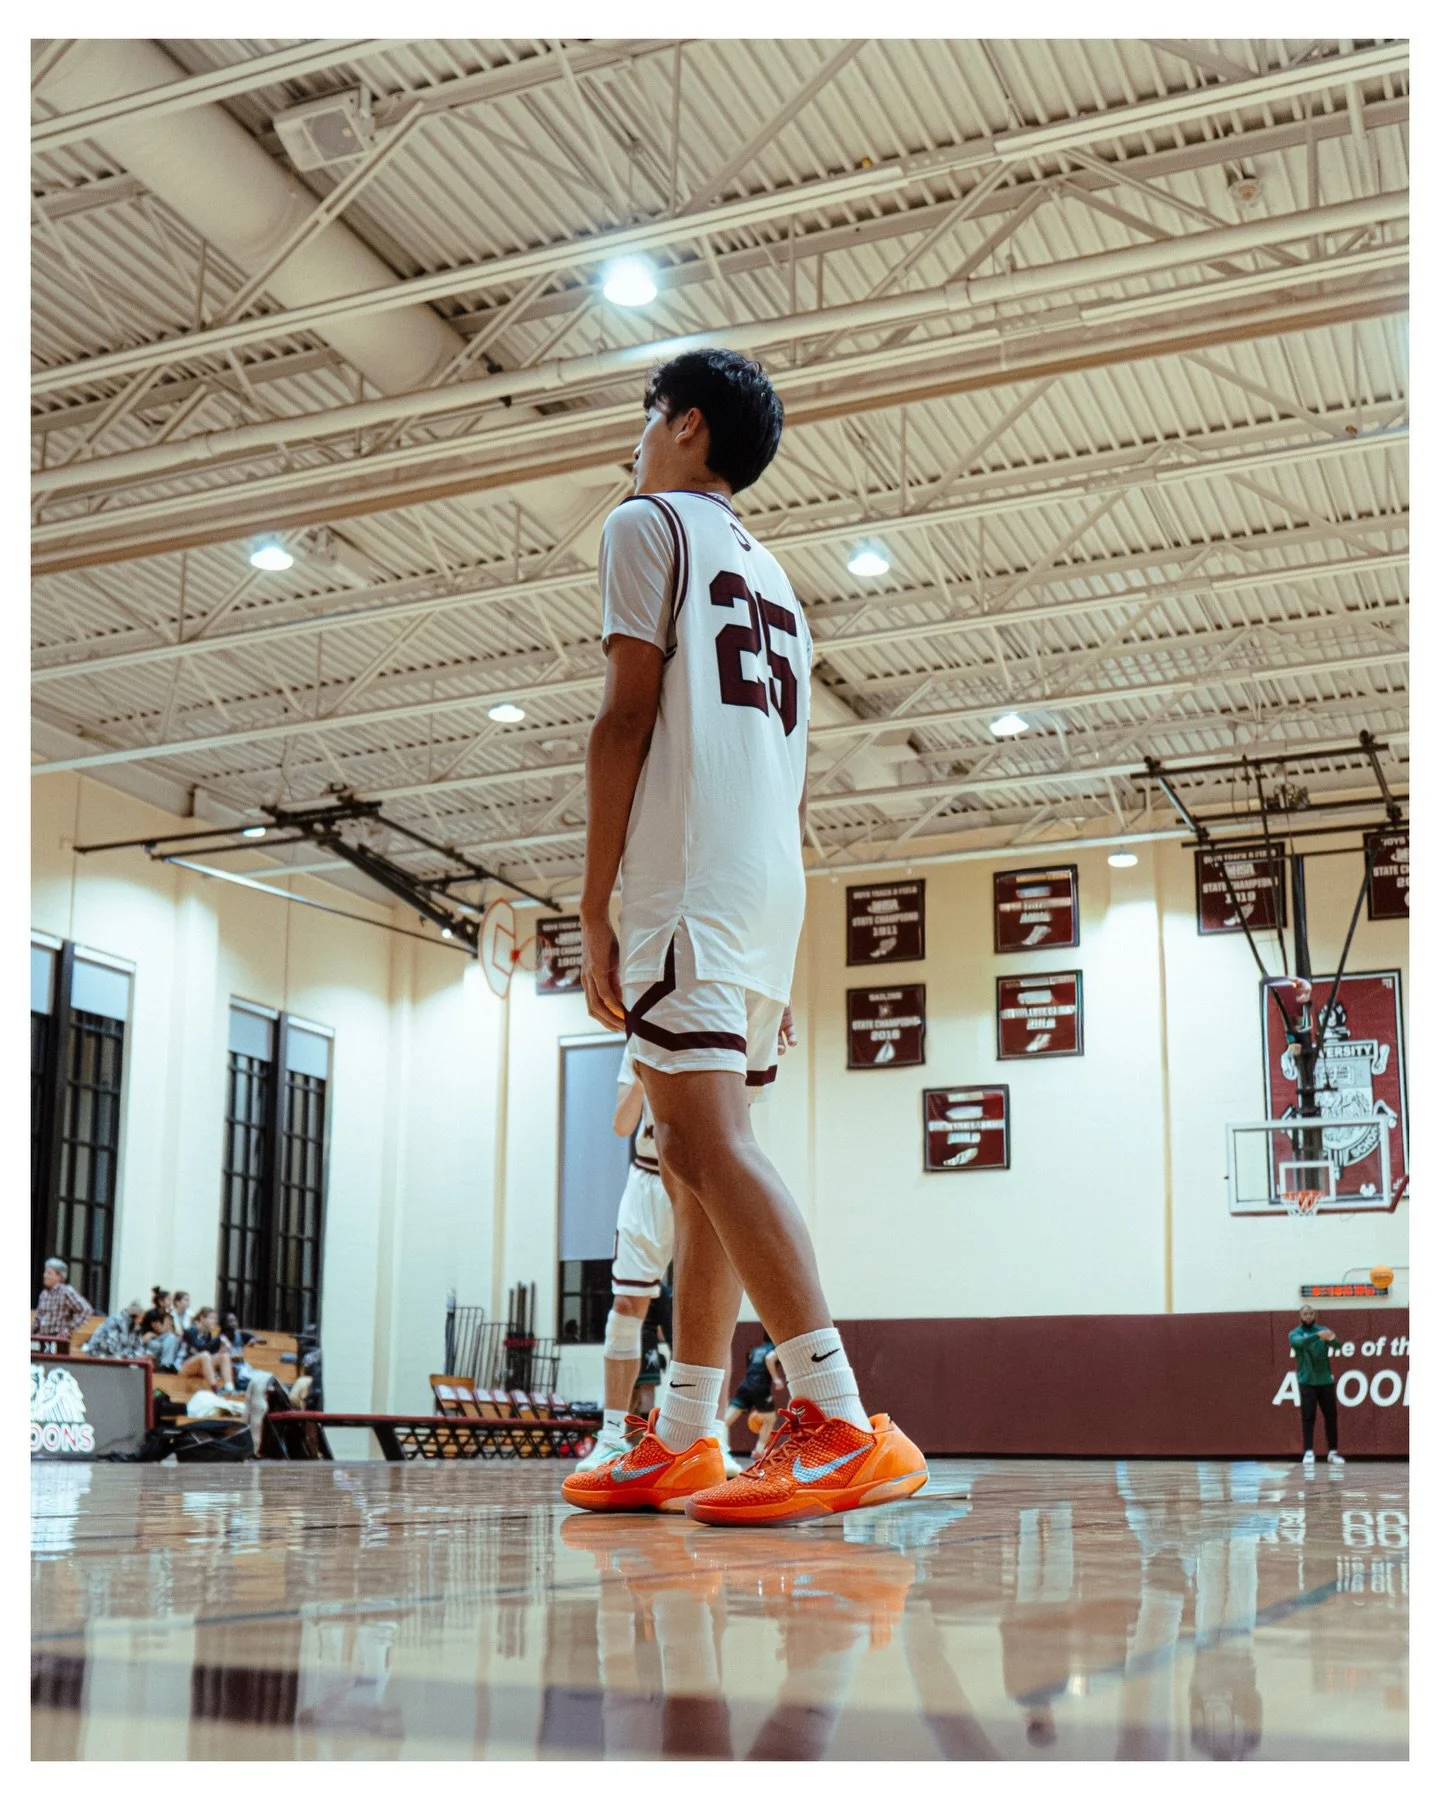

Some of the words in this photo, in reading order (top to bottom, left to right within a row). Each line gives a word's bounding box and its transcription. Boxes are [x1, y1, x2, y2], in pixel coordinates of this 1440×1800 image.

[709, 570, 798, 737] 25
[1229, 876, 1279, 890] HAMPIONS
[1361, 1336, 1386, 1357] of
